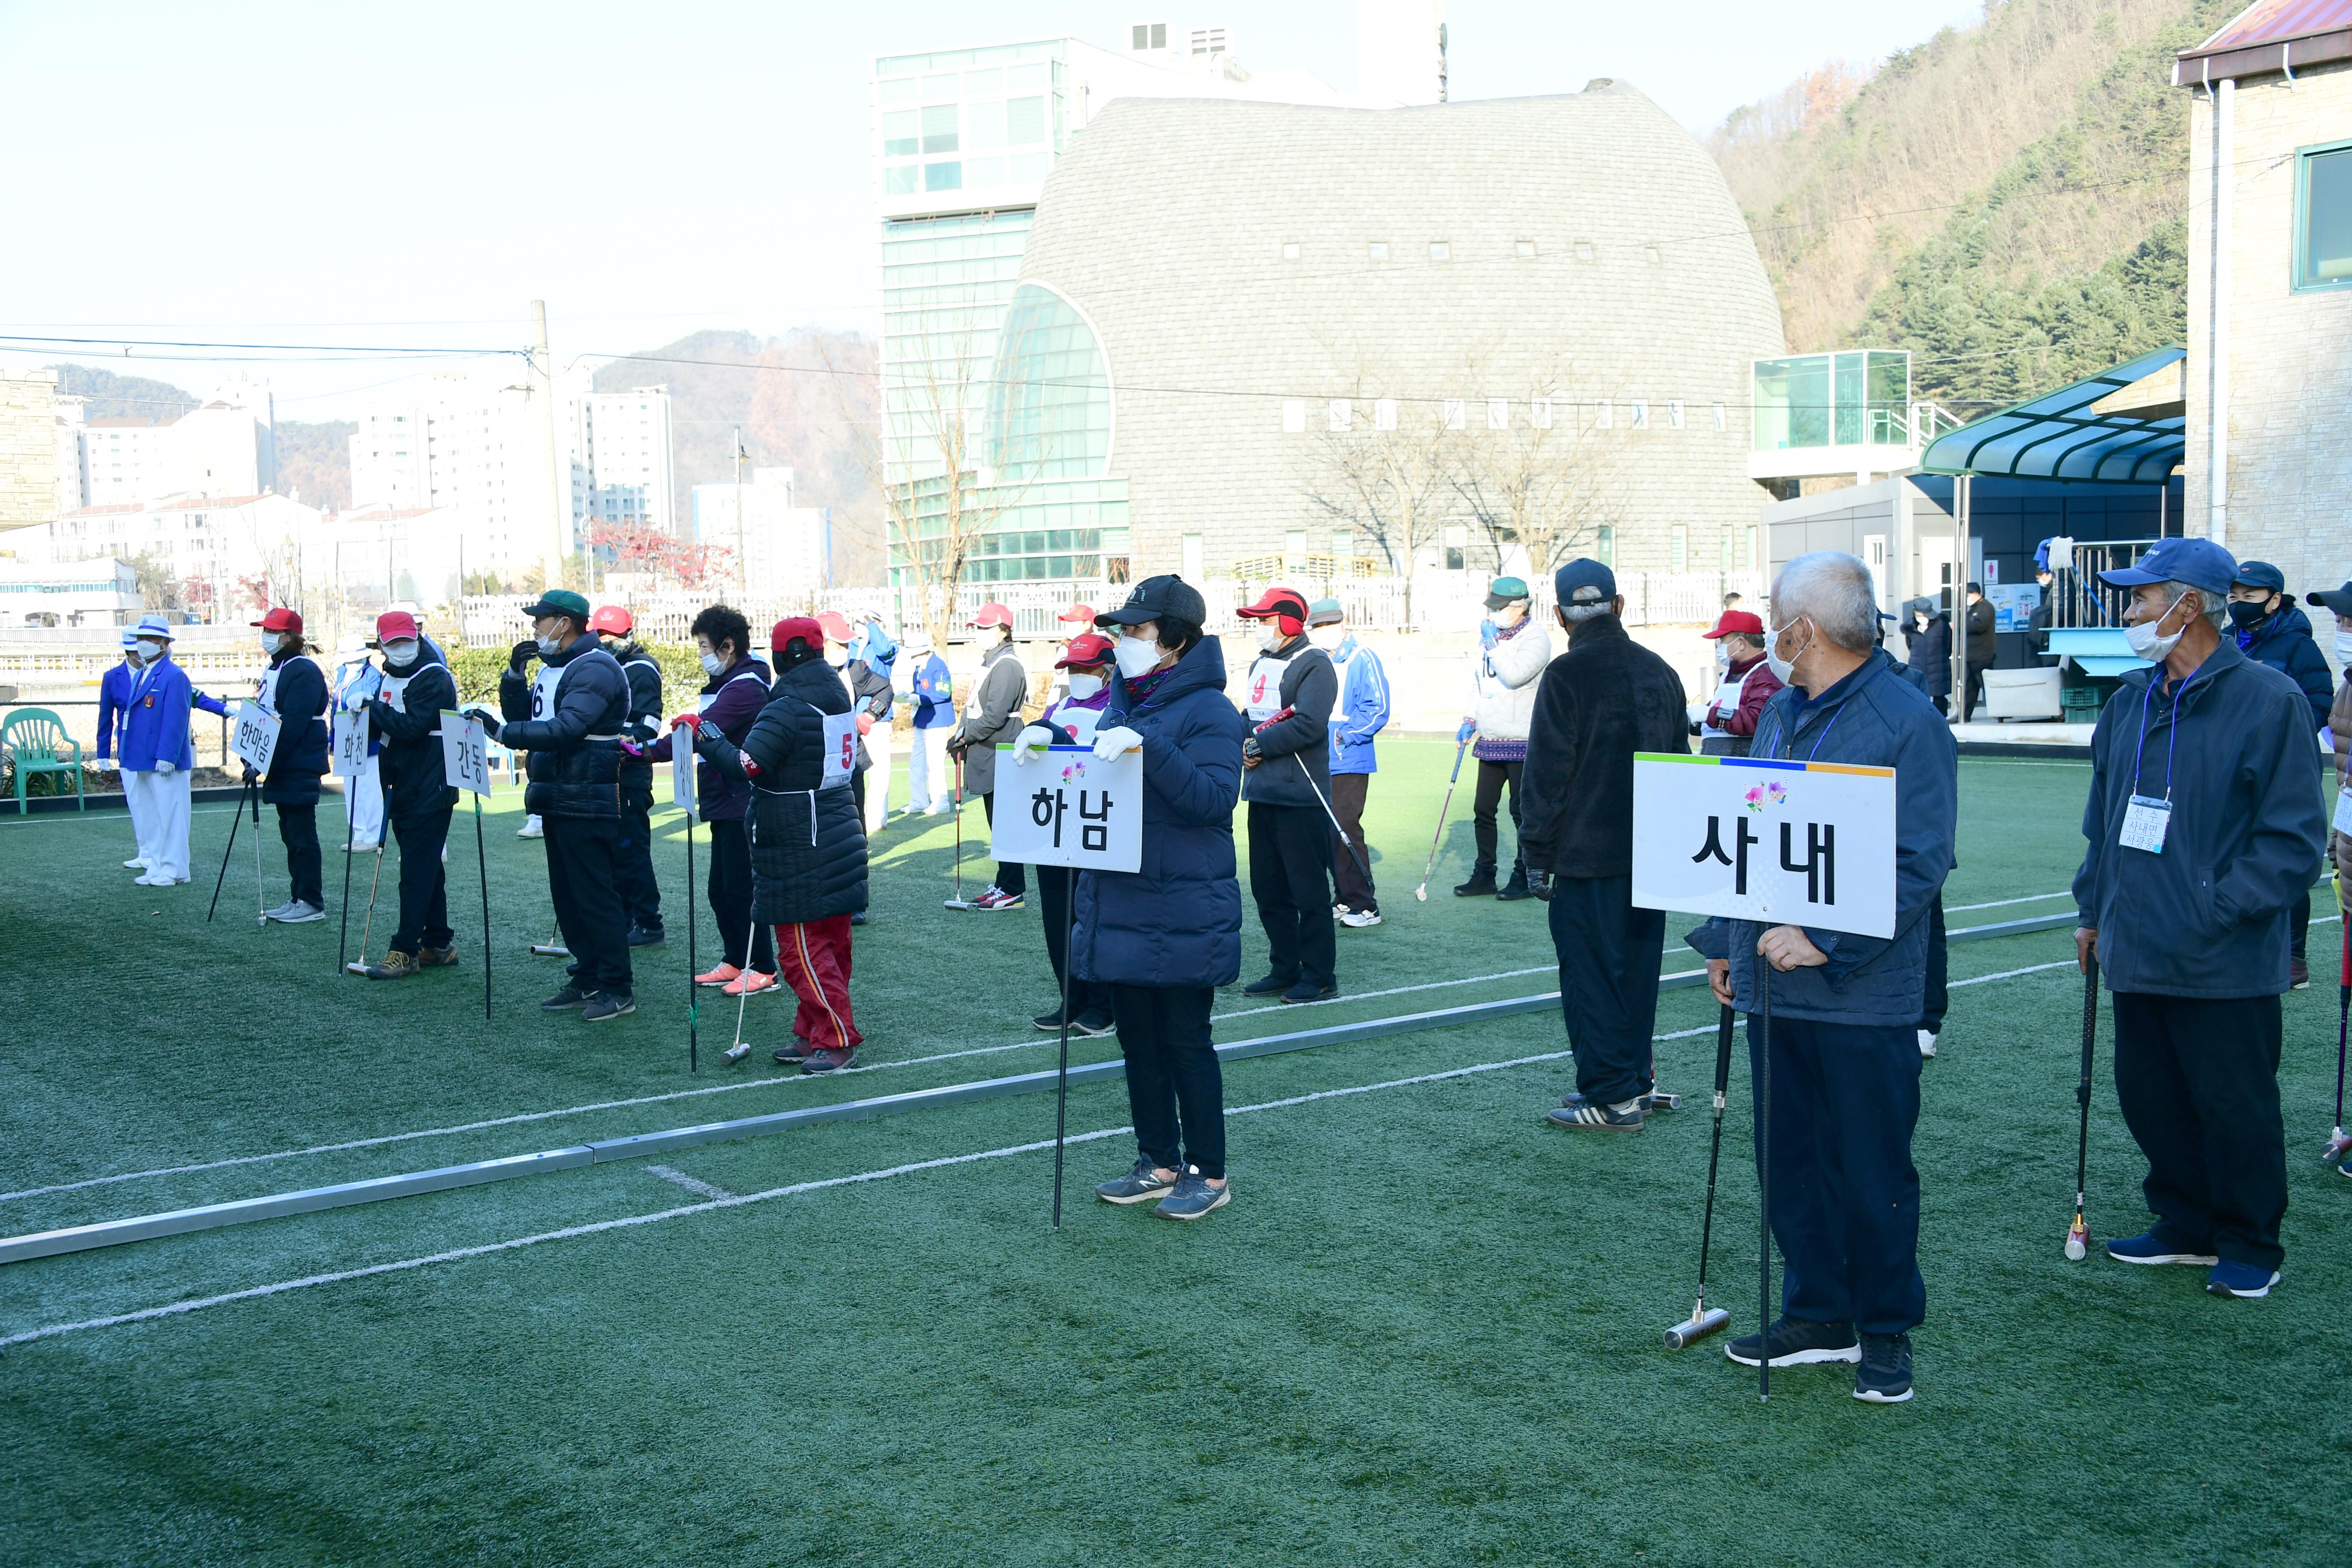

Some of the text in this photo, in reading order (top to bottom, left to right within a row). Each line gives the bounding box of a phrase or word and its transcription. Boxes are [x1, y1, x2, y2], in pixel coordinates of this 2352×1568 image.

[533, 683, 543, 717] 6
[1252, 674, 1266, 703] 9
[240, 720, 270, 764] 한마음
[344, 732, 363, 766] 화천
[842, 733, 852, 769] 5
[457, 741, 482, 784] 간동
[1032, 787, 1113, 852] 하남
[2129, 821, 2158, 836] 사내면
[2339, 808, 2352, 822] 사내
[2126, 834, 2154, 849] 서광웅
[1691, 815, 1835, 905] 사내
[1690, 1320, 1725, 1341] HATACHI
